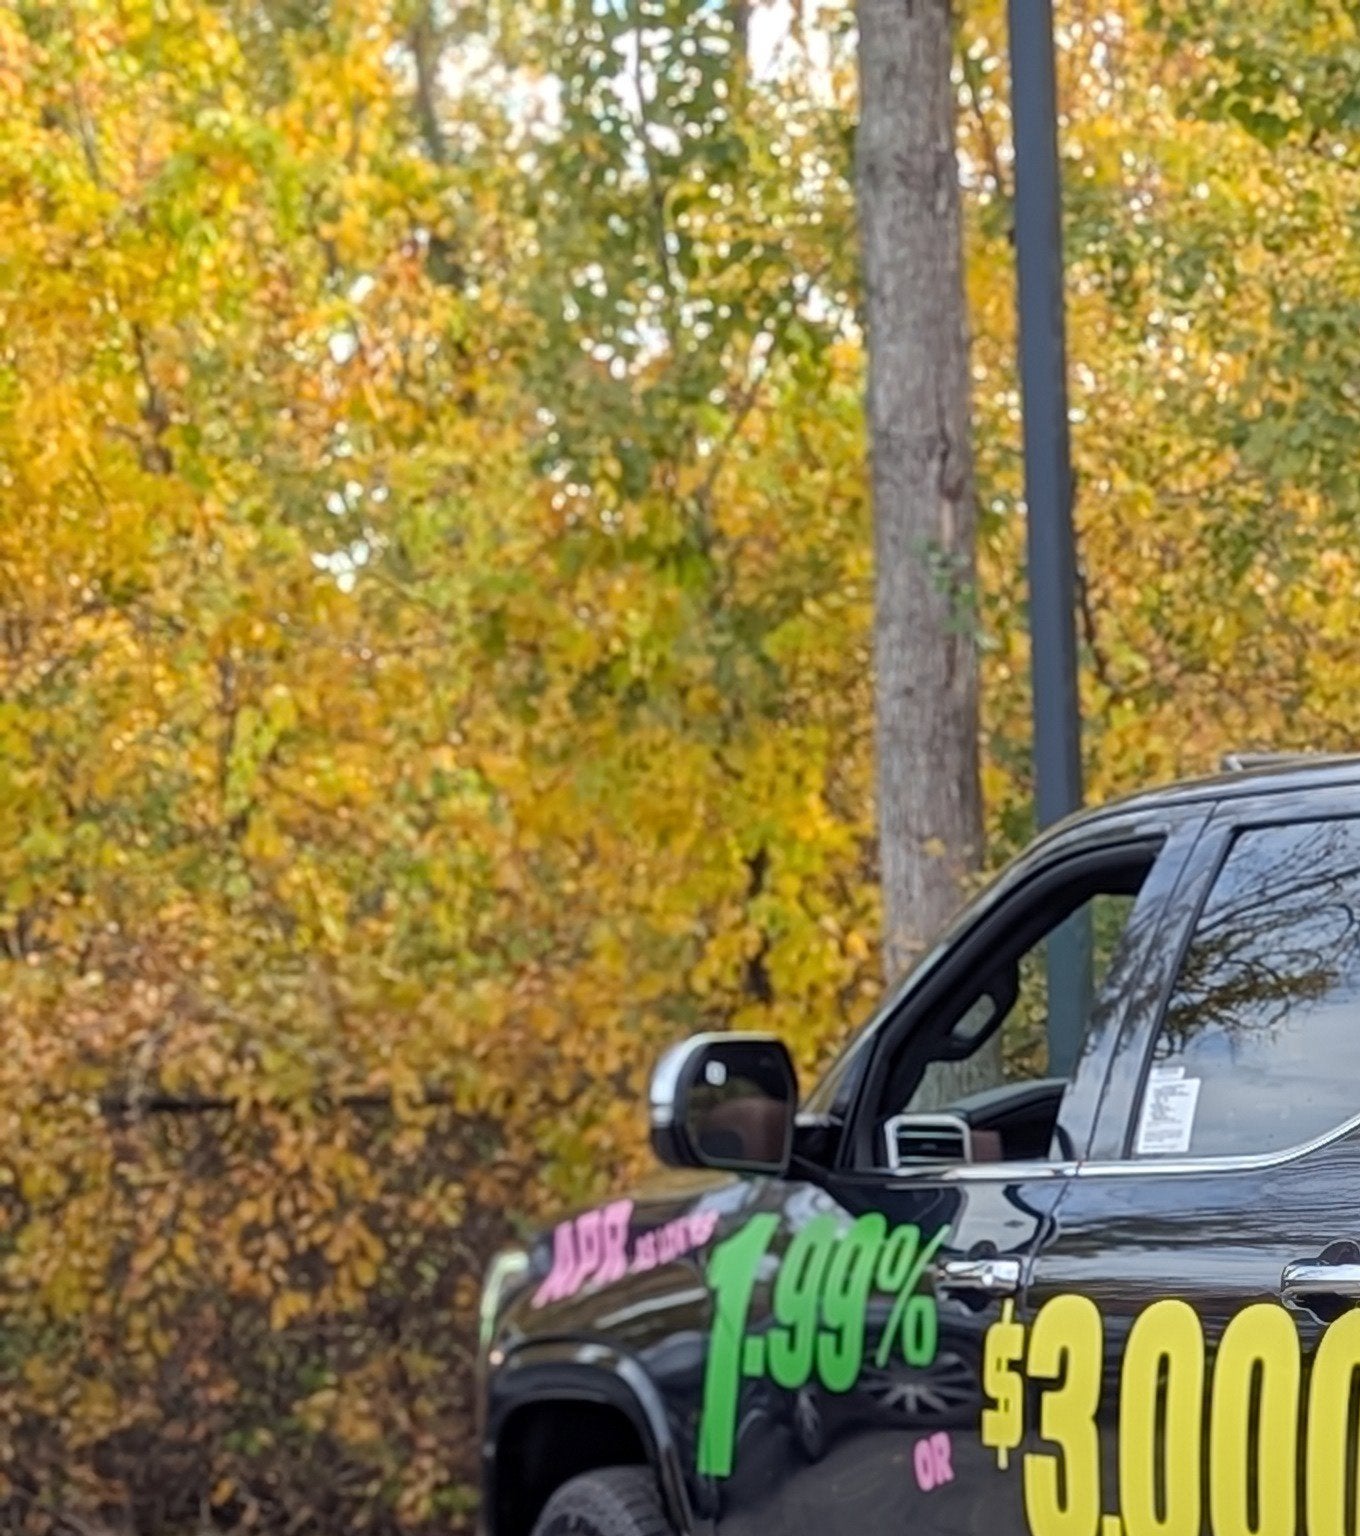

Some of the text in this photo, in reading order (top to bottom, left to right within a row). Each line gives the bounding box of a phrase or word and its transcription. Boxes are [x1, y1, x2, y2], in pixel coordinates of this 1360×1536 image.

[531, 1198, 635, 1309] APR
[697, 1211, 951, 1477] 1.99%
[913, 1430, 955, 1492] OR
